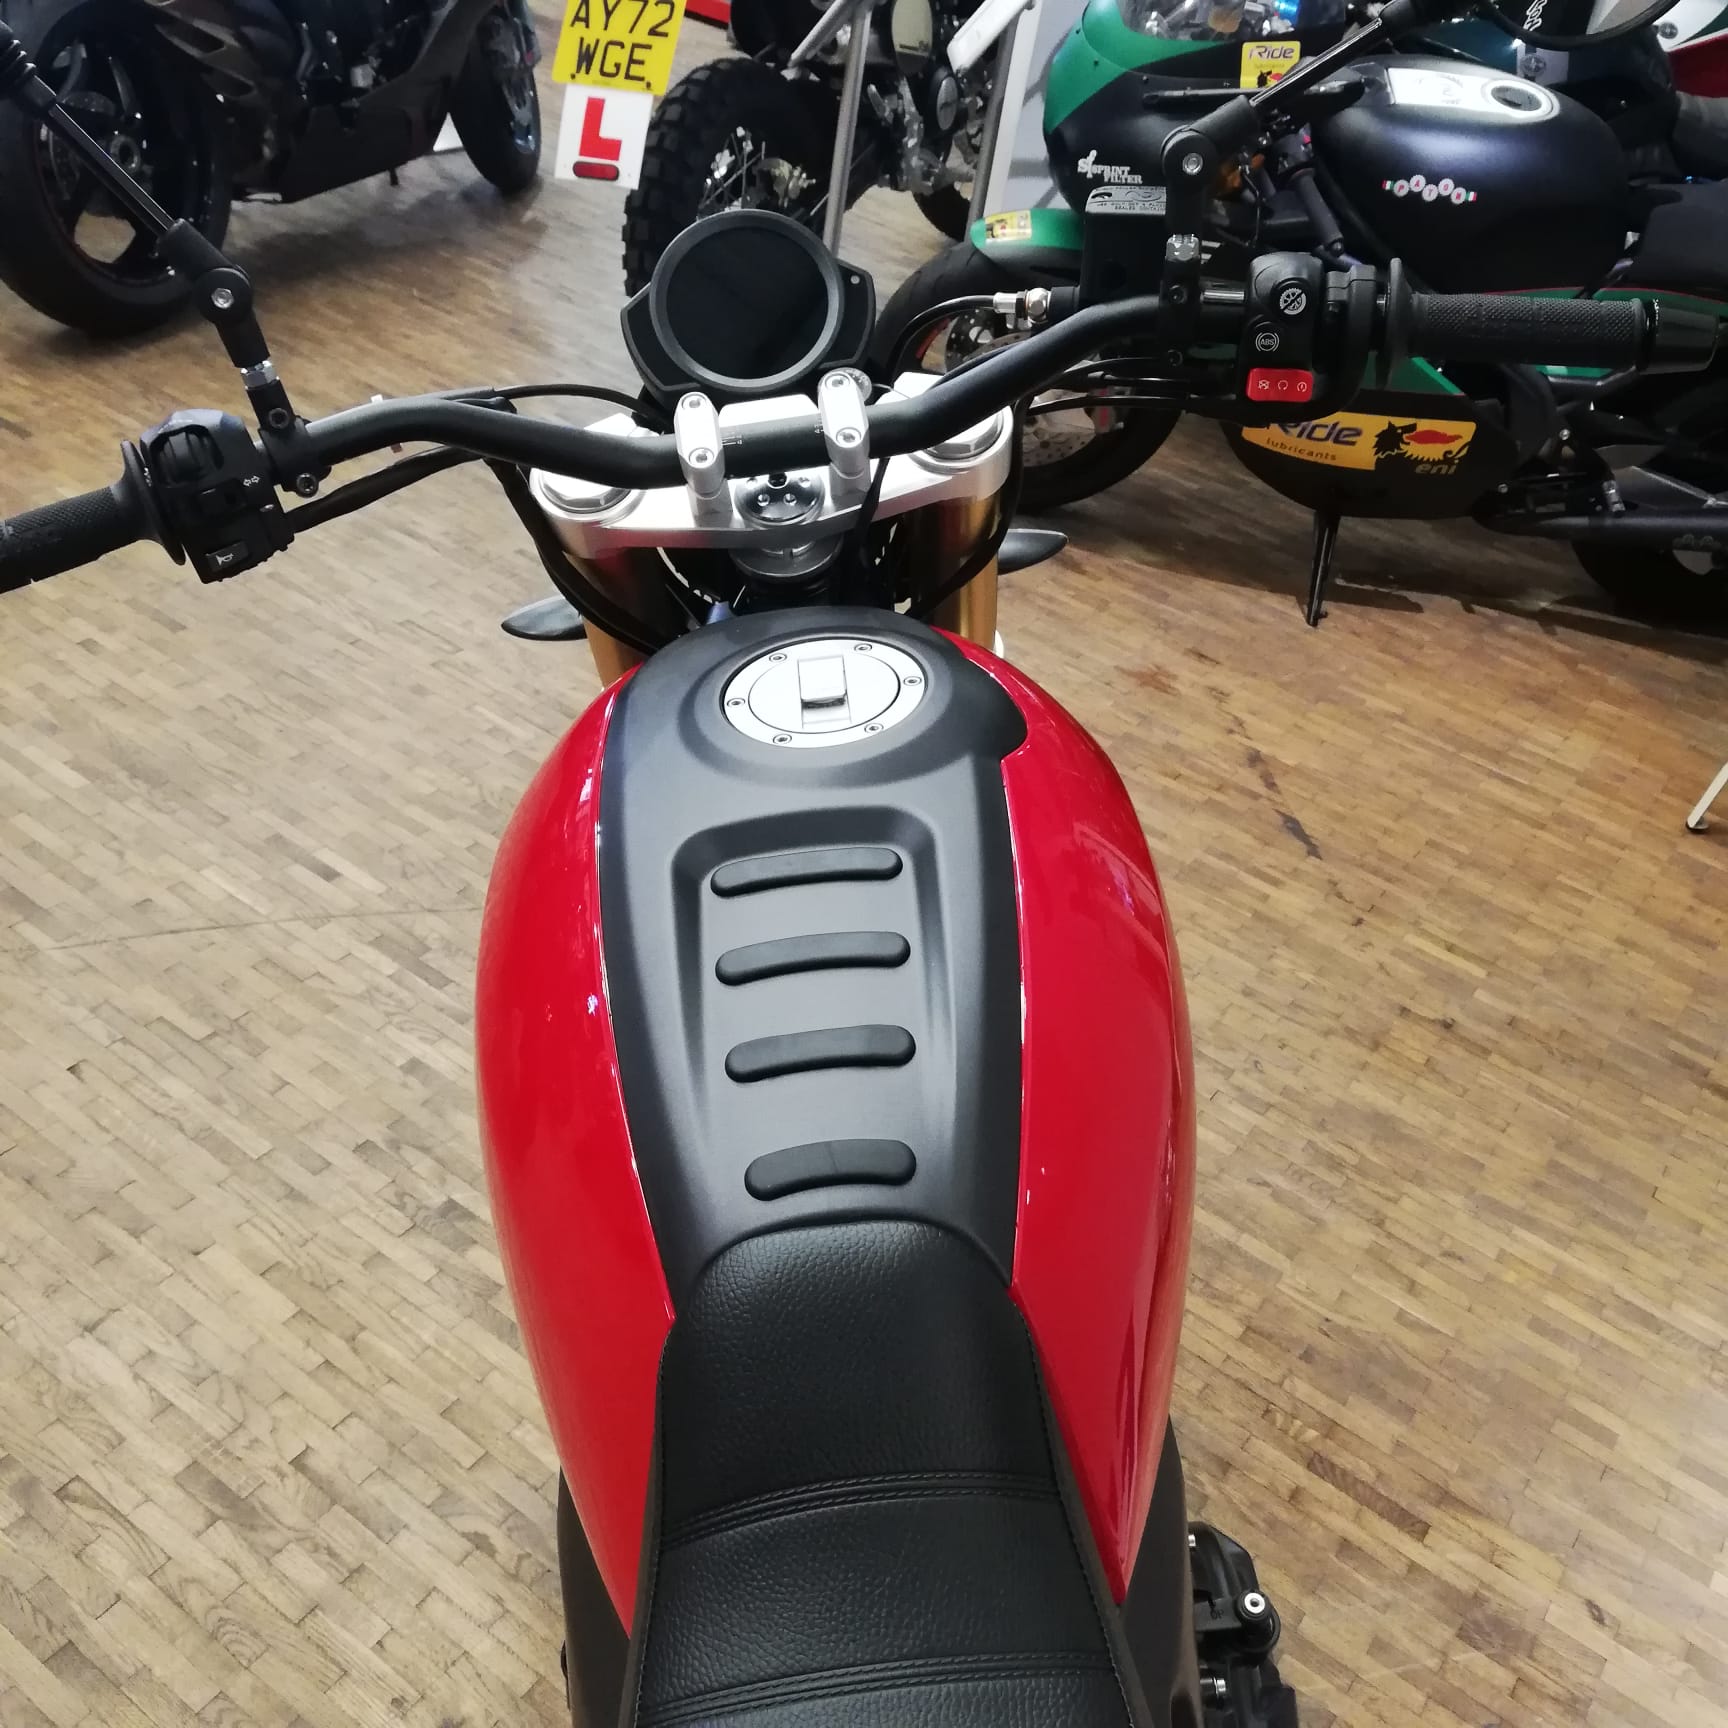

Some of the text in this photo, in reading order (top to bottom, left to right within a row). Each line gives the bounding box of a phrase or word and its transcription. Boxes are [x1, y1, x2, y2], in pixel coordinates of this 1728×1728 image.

[570, 0, 676, 38] AY72
[575, 37, 653, 82] WGE
[579, 96, 622, 161] L
[1261, 338, 1275, 346] ABS
[1266, 438, 1337, 461] lubricants
[1415, 459, 1459, 475] eni
